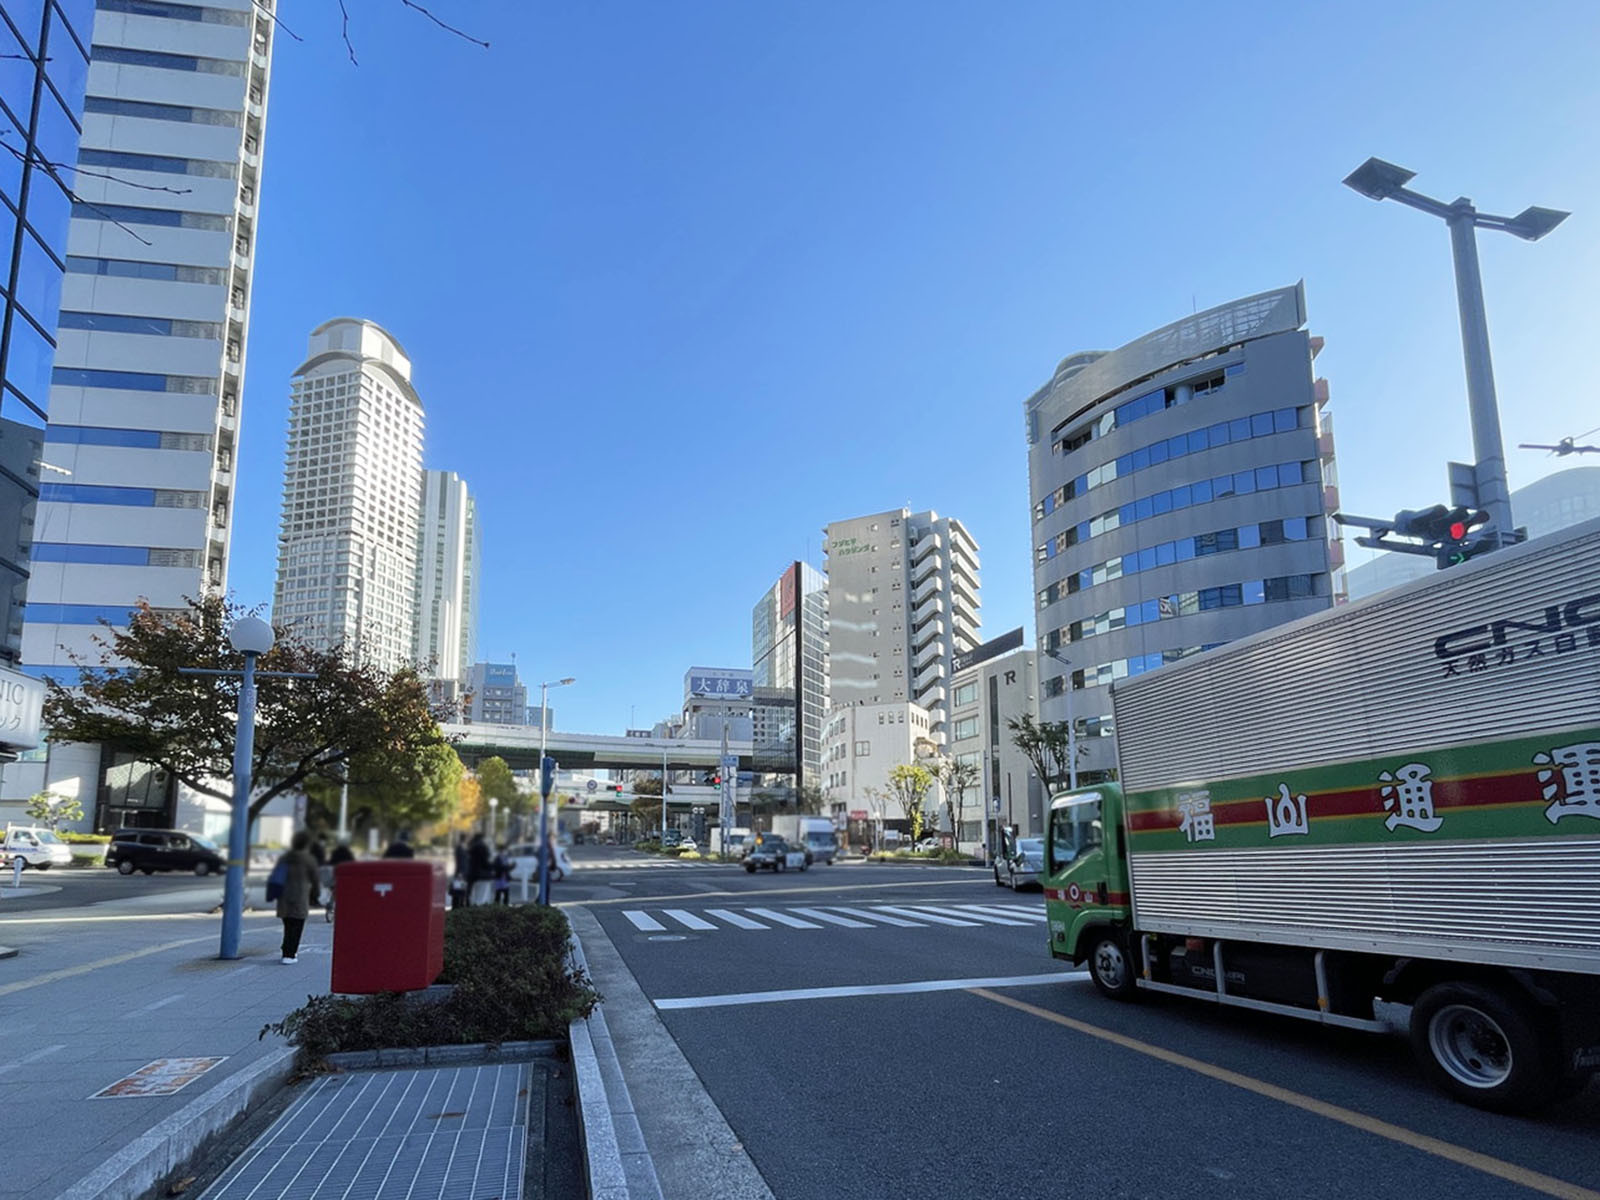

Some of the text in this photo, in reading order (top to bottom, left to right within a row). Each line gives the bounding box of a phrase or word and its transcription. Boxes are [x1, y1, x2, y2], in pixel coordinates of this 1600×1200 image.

[697, 677, 749, 694] 大辞泉
[1178, 742, 1600, 843] 福山通運
